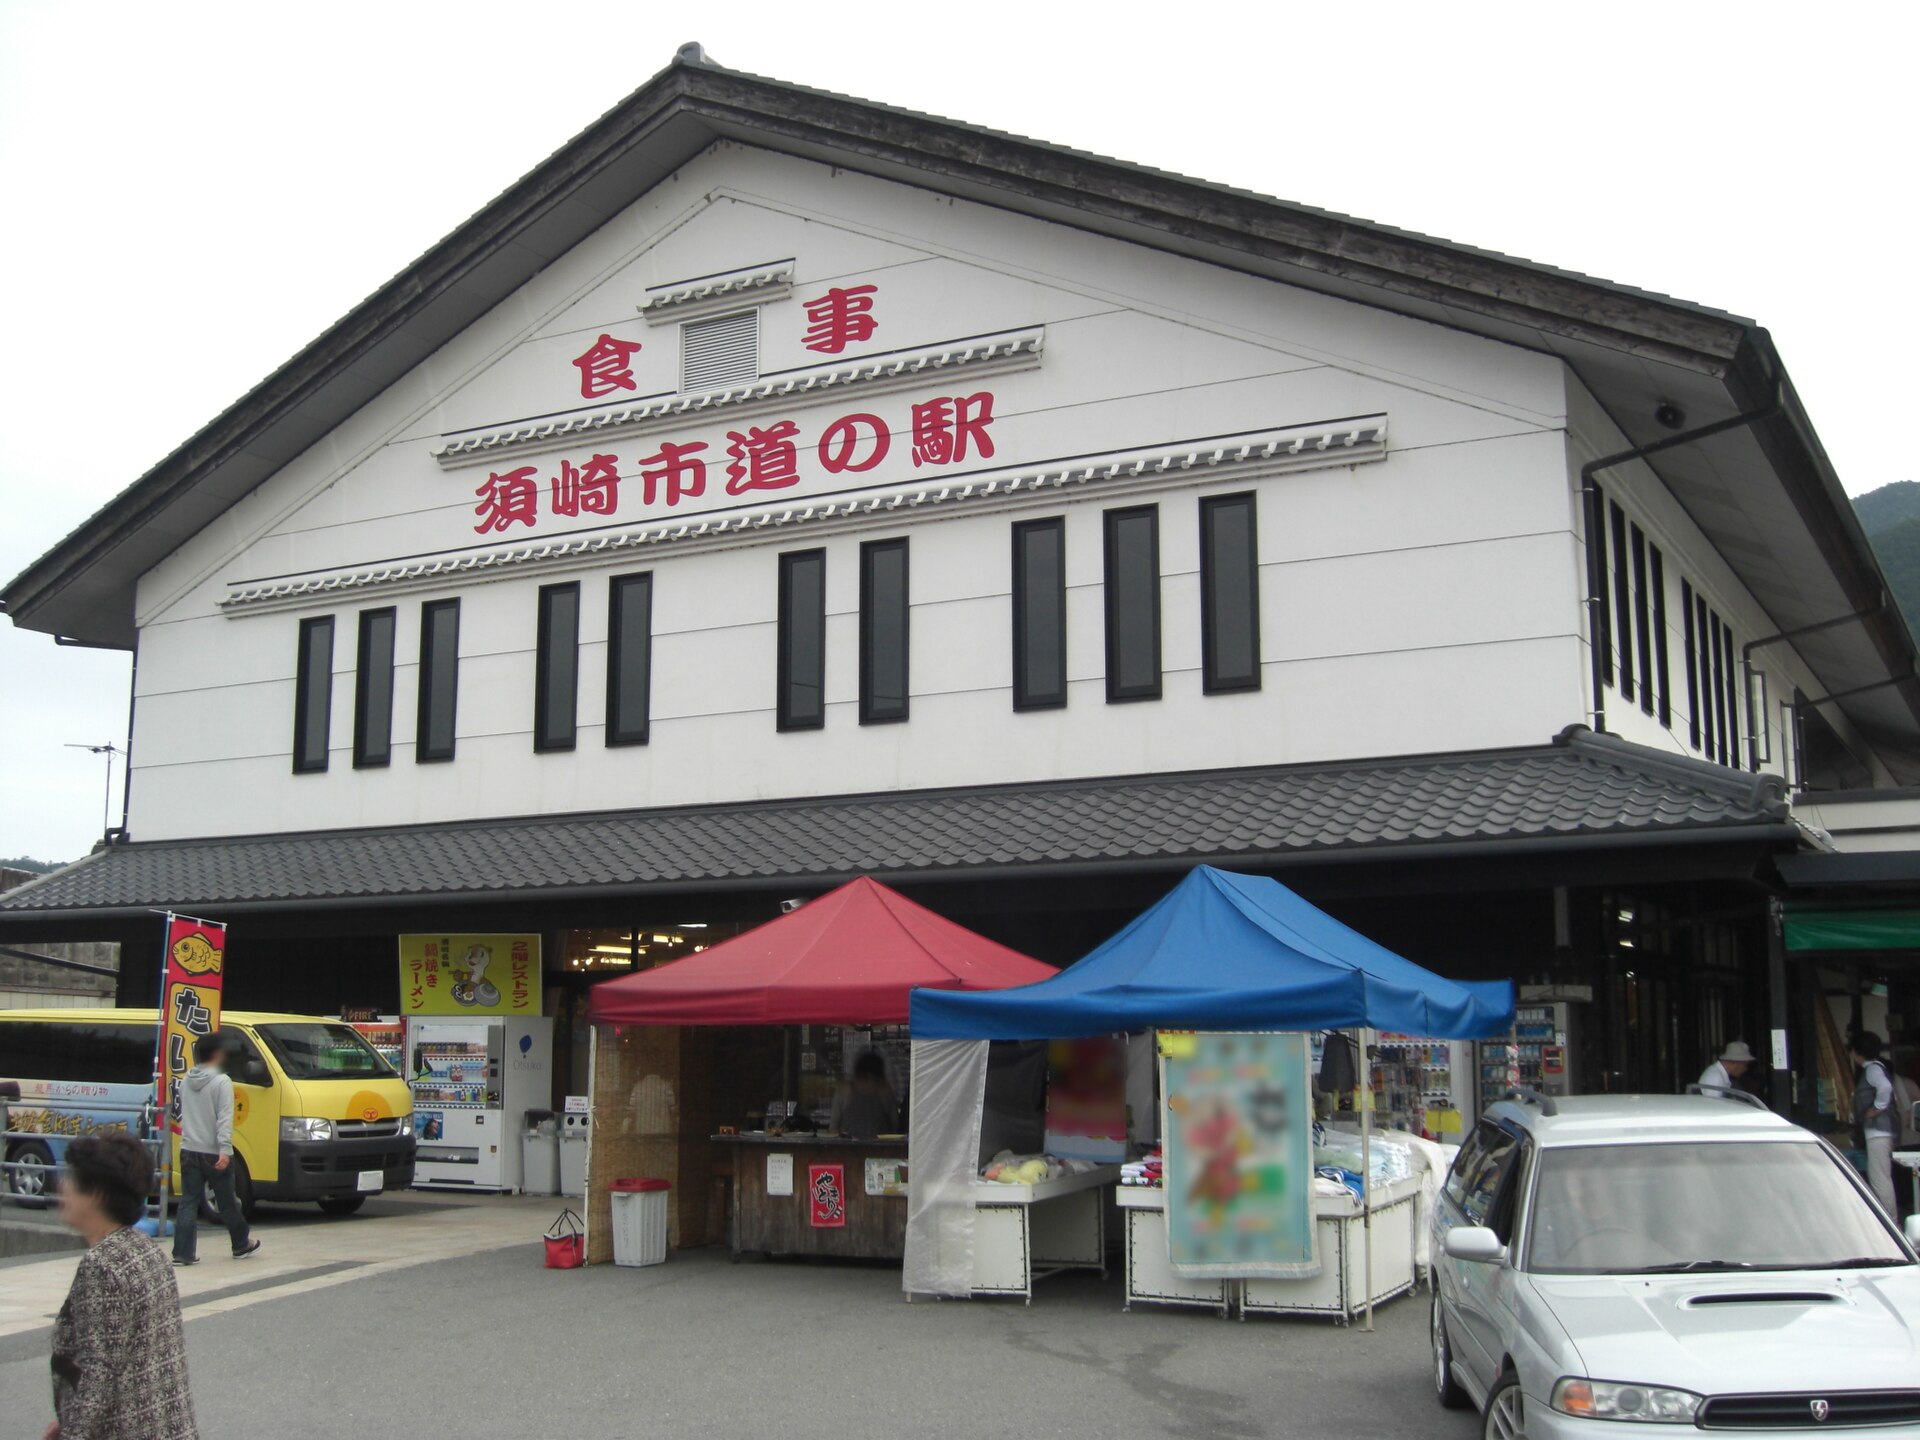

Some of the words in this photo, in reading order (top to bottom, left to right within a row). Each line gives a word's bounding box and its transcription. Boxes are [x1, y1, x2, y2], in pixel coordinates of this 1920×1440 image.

[572, 333, 642, 399] 食
[801, 284, 879, 354] 事
[473, 391, 995, 534] 須崎市道の駅
[409, 959, 425, 1009] ラーメン
[354, 1011, 372, 1020] FIRE
[814, 1171, 841, 1220] やきとり
